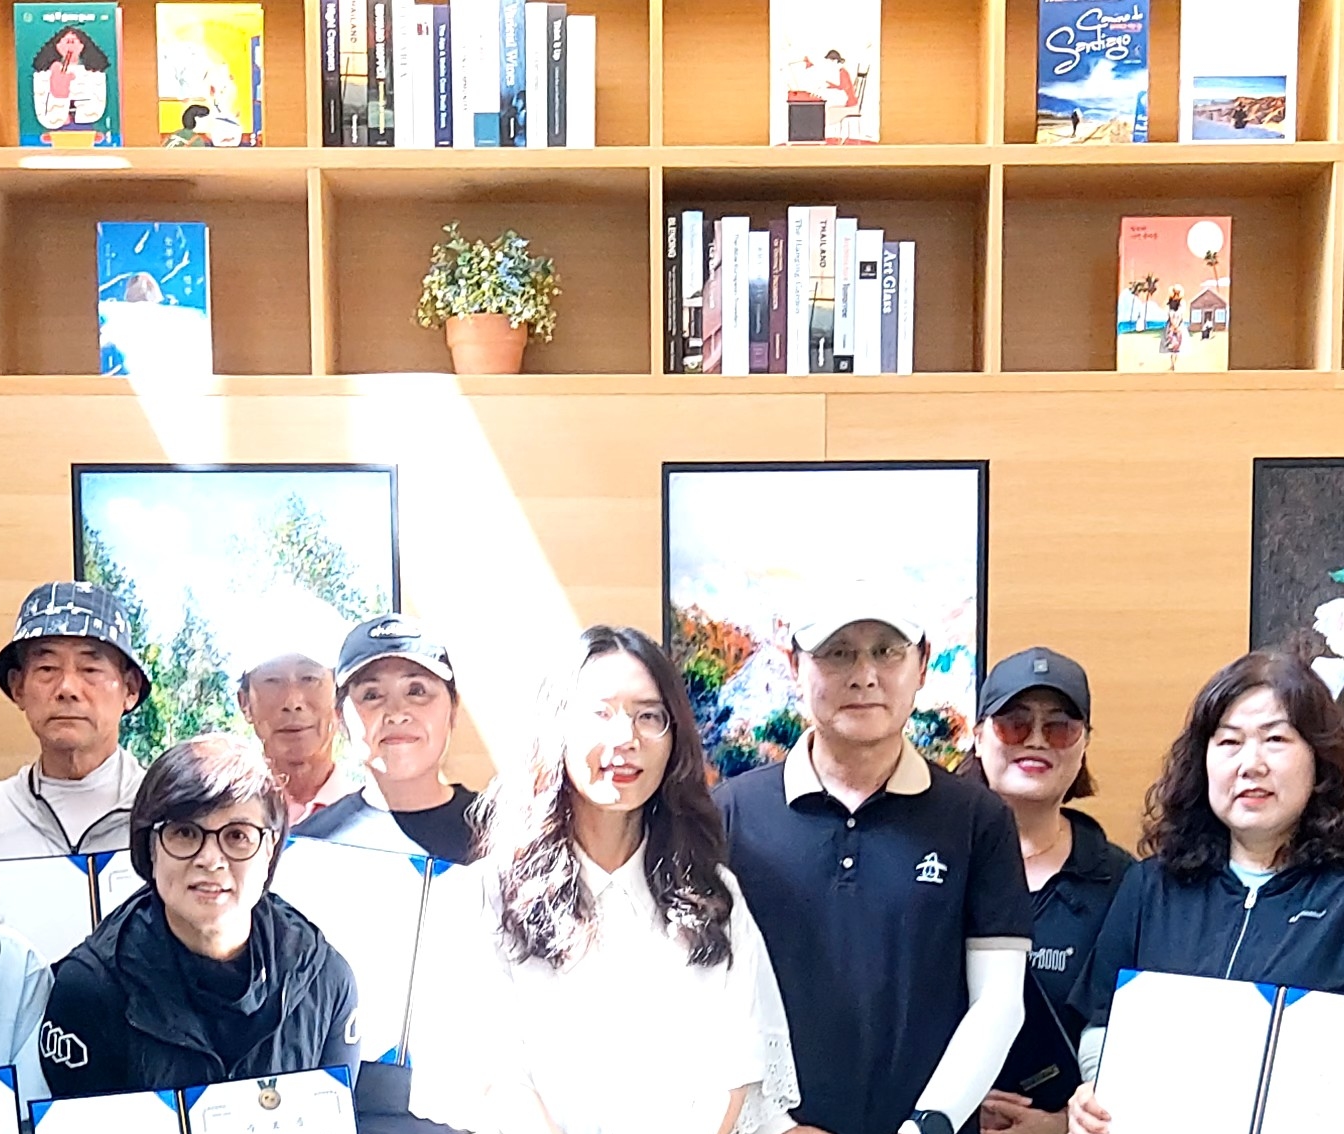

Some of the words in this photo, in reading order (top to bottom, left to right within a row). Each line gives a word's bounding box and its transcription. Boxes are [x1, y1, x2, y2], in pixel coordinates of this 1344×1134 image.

[1045, 26, 1132, 75] Santiago
[819, 221, 827, 268] THAILAND
[883, 250, 897, 274] Art
[882, 275, 896, 314] Glass
